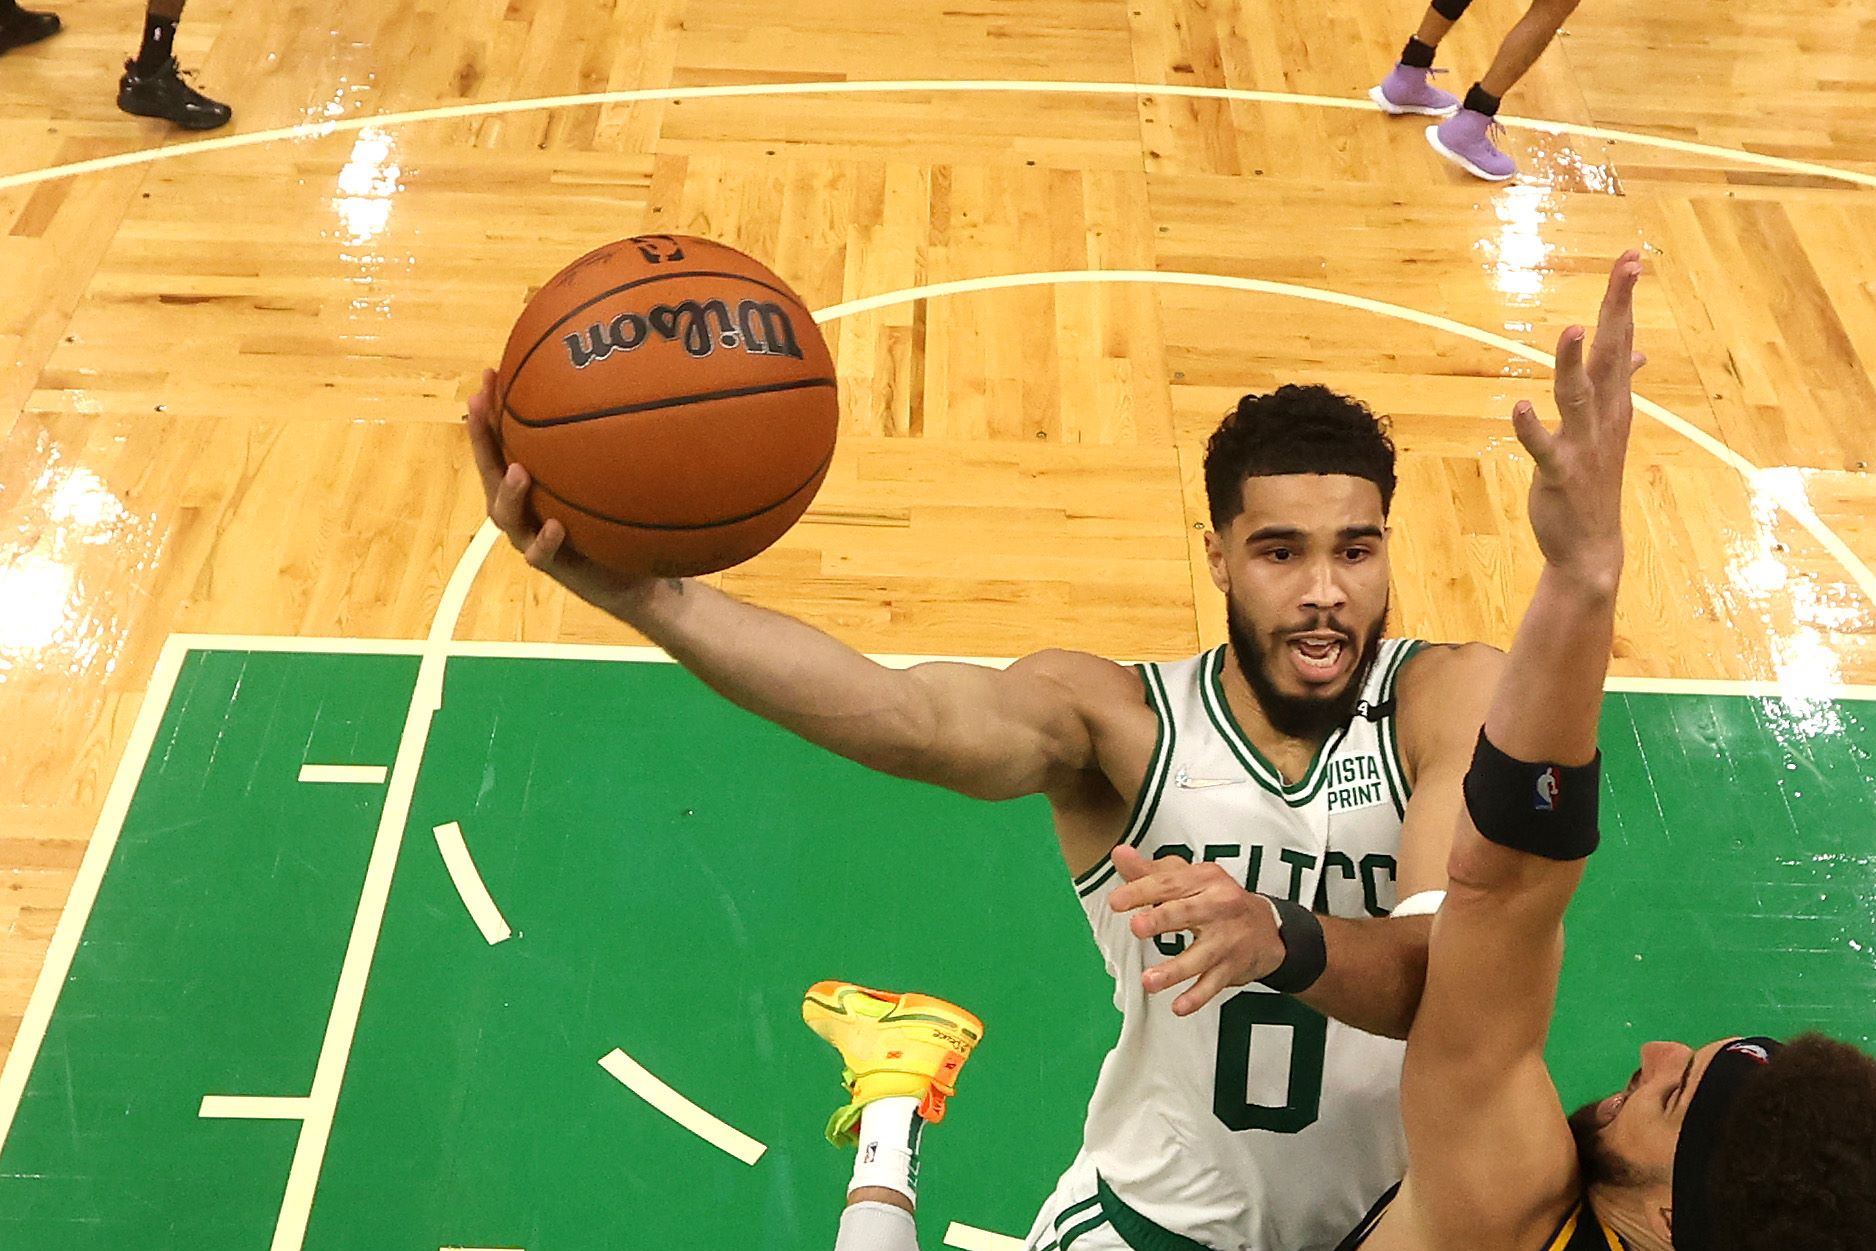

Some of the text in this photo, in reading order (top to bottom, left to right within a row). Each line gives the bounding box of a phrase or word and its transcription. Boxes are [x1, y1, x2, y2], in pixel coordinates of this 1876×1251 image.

[563, 299, 804, 369] Wilson
[1327, 756, 1380, 789] VISTA
[1328, 782, 1381, 811] PRINT
[1213, 990, 1328, 1134] 0
